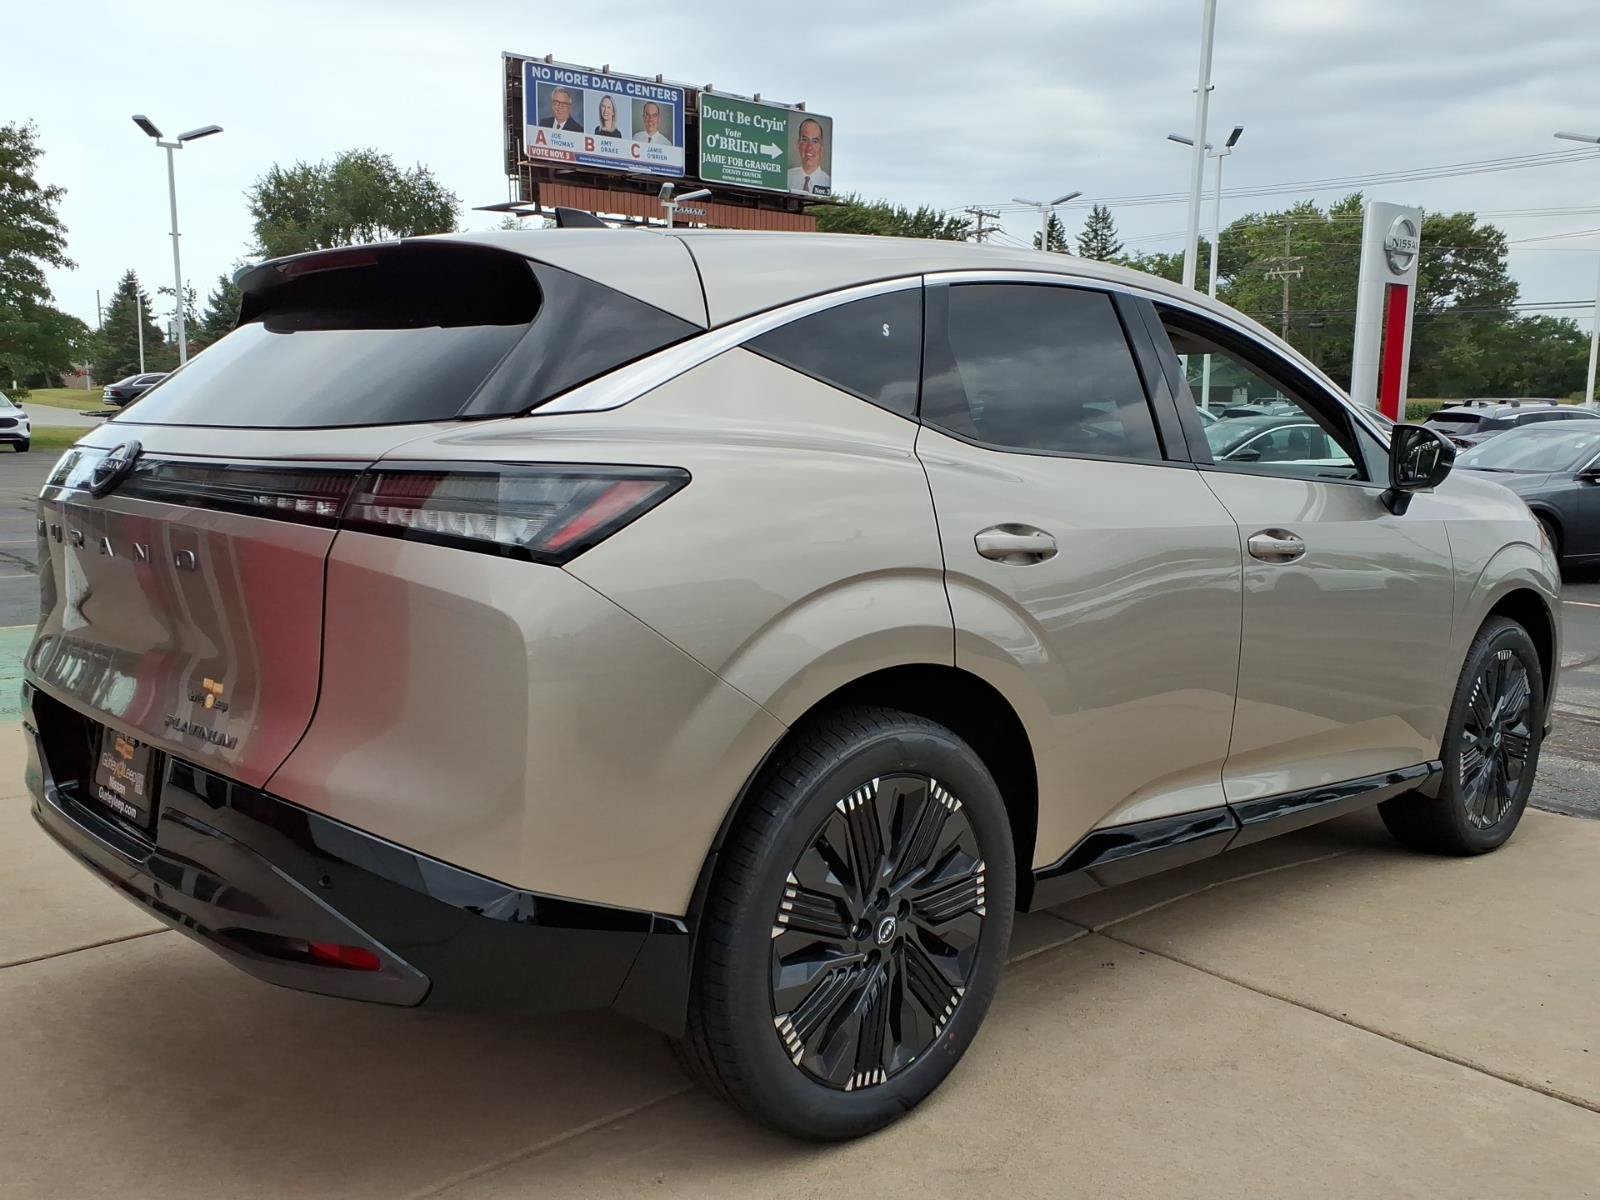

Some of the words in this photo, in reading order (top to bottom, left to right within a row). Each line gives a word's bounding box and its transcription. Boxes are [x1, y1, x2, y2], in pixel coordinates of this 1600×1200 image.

[532, 66, 551, 79] NO
[554, 70, 589, 87] MORE
[592, 77, 623, 93] DATA
[626, 83, 678, 101] CENTERS
[703, 105, 734, 123] Don't
[736, 111, 751, 126] Be
[753, 115, 786, 132] Cryin'
[536, 130, 547, 145] A
[725, 128, 742, 138] Vote
[551, 140, 574, 149] THOMAS
[585, 137, 595, 152] B
[600, 147, 620, 155] DRAKE
[631, 143, 641, 158] C
[647, 146, 664, 154] JAMIE
[706, 134, 758, 154] O'BRIEN
[531, 147, 549, 157] VOTE
[550, 151, 565, 160] NOV.
[647, 153, 668, 161] O'BRIEN
[703, 152, 727, 165] JAMIE
[727, 156, 744, 167] FOR
[744, 159, 781, 172] GRANGER
[722, 168, 741, 176] COUNTY
[741, 171, 762, 179] COUNCIL
[882, 323, 889, 337] S
[165, 713, 238, 750] PLATINUM
